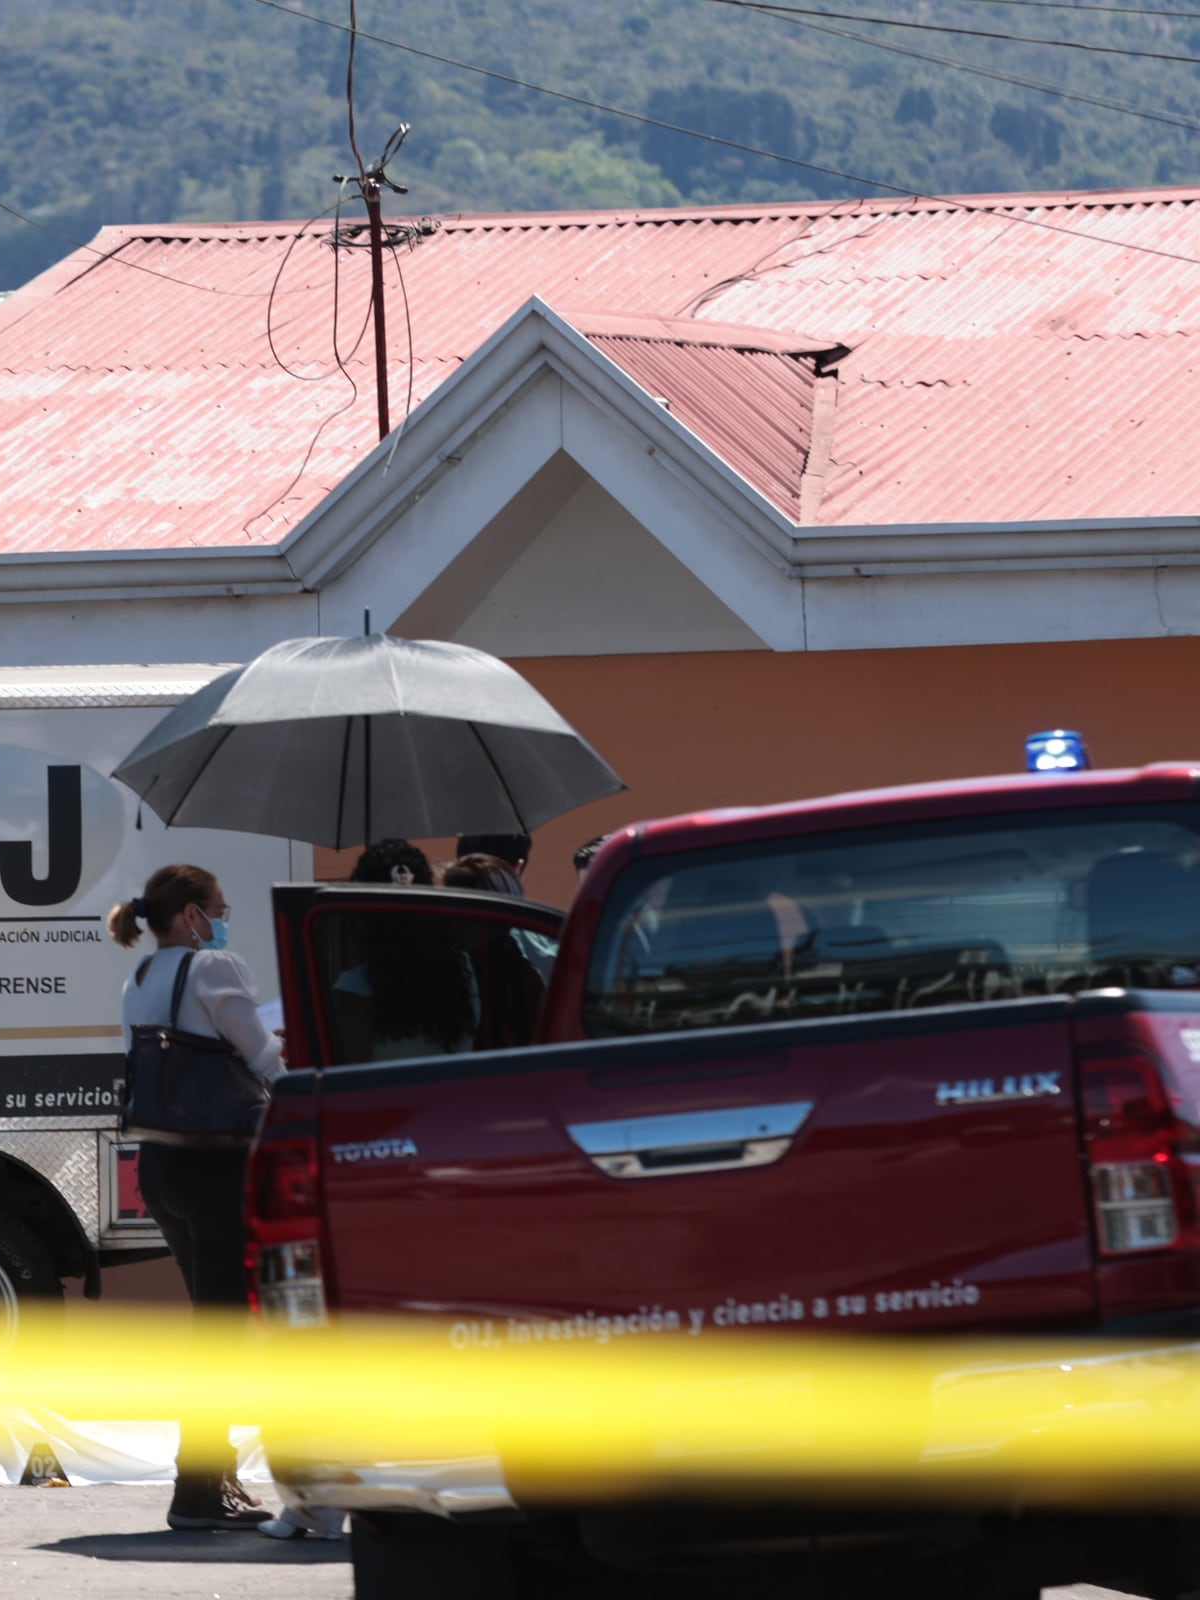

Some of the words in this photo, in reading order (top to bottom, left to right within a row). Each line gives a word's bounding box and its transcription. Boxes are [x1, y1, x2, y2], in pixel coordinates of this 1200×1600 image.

[44, 930, 102, 943] JUDICIAL
[6, 1094, 26, 1108] su
[35, 1086, 113, 1107] servicio
[936, 1071, 1061, 1105] HILUX
[330, 1138, 418, 1163] TOYOTA
[507, 1305, 680, 1344] investigación
[687, 1308, 705, 1336] y
[713, 1292, 804, 1326] ciencia
[813, 1298, 828, 1319] a
[836, 1295, 866, 1316] su
[874, 1278, 981, 1312] servicio
[31, 1455, 58, 1478] 02
